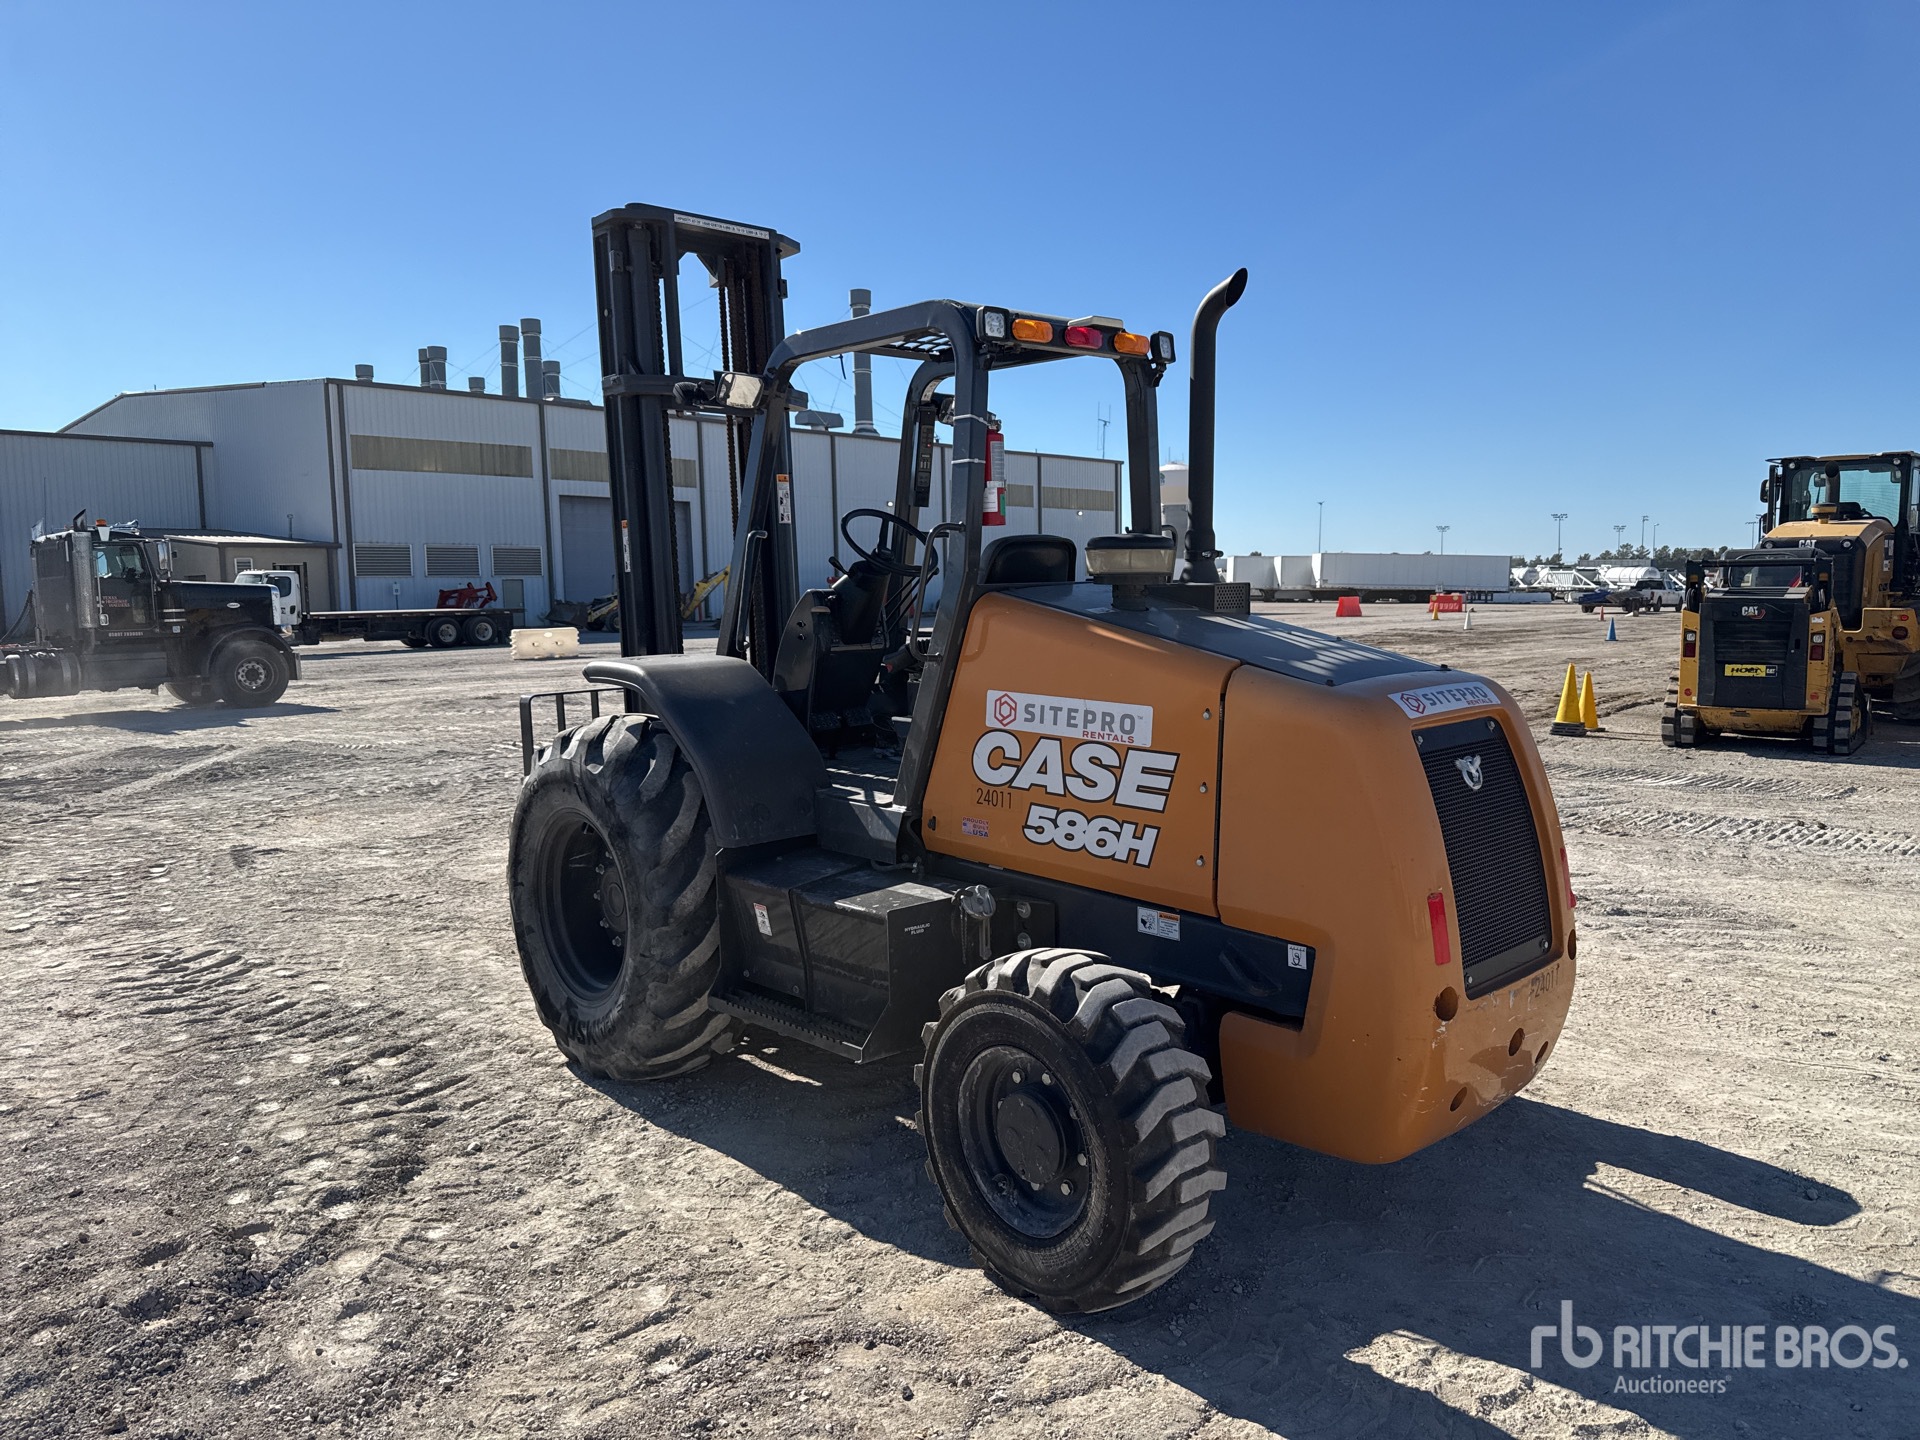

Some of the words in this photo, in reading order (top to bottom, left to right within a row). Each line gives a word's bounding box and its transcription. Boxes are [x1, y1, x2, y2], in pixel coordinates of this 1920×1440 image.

[1798, 539, 1817, 549] CAT
[1741, 606, 1758, 616] CAT
[1421, 686, 1488, 707] SITEPRO
[1023, 703, 1136, 736] SITEPRO
[1082, 730, 1135, 744] RENTALS
[972, 729, 1180, 813] CASE
[976, 787, 1012, 809] 24011
[962, 816, 989, 826] PROUDLY
[972, 829, 989, 838] USA
[1022, 802, 1161, 868] 586H
[904, 922, 930, 932] HYDRAULIC
